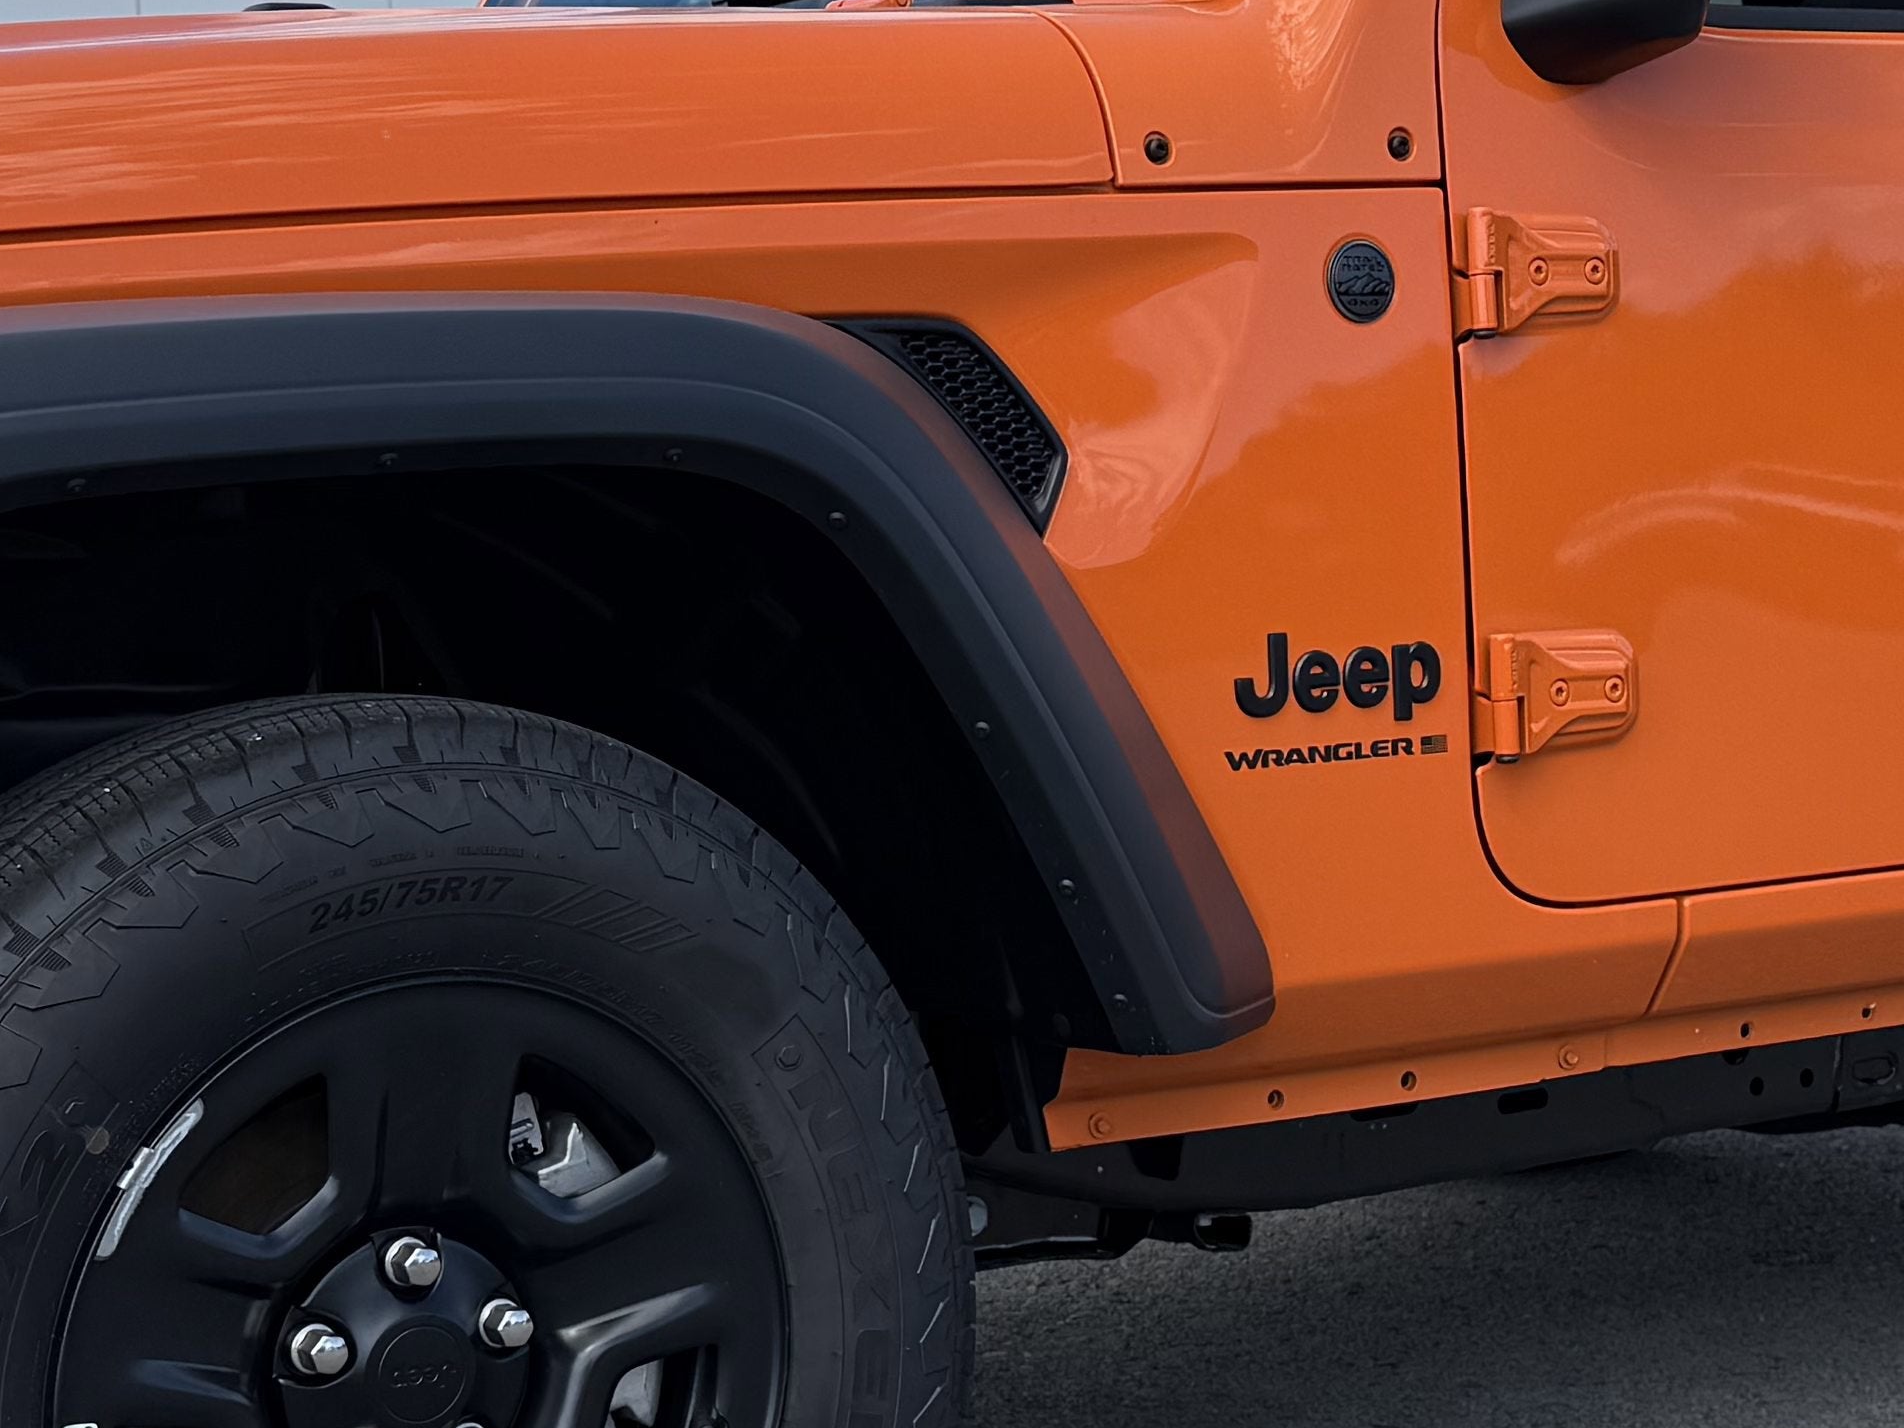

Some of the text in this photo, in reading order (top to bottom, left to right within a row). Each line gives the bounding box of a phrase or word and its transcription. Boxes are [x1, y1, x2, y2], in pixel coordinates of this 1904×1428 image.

[1233, 632, 1441, 721] Jeep
[1223, 736, 1415, 772] WRANGLER
[307, 874, 515, 935] 245/75R17
